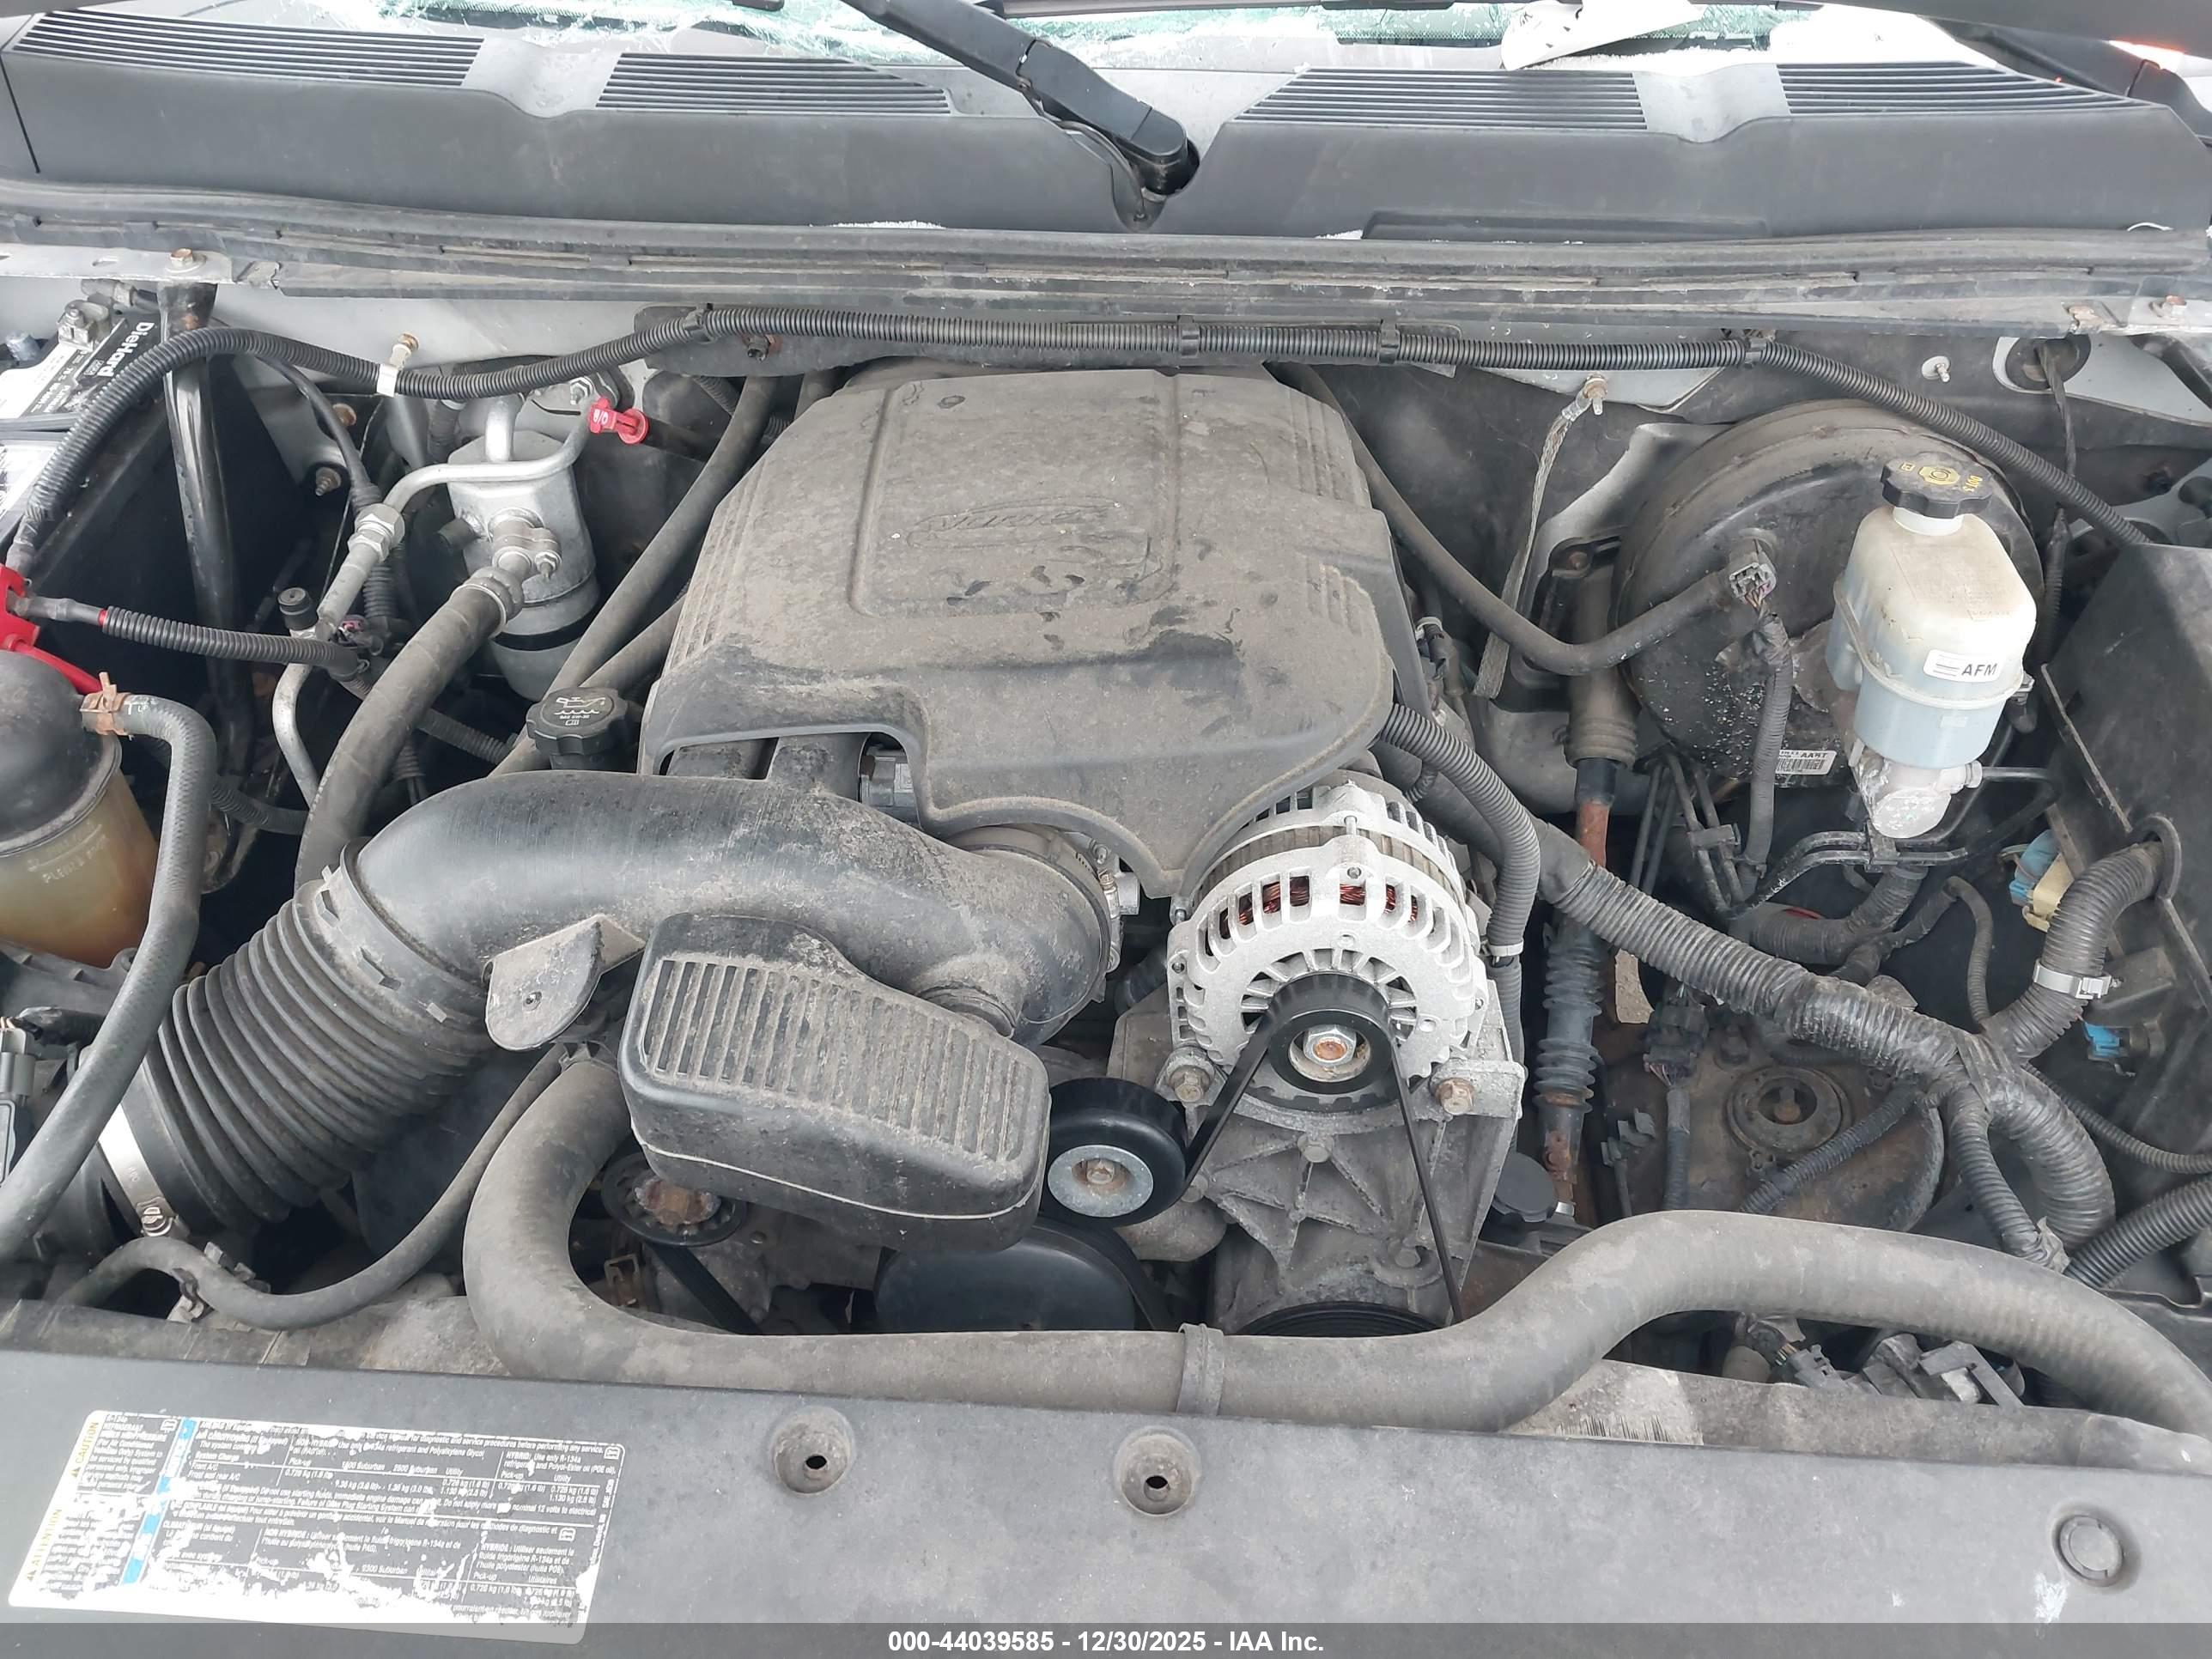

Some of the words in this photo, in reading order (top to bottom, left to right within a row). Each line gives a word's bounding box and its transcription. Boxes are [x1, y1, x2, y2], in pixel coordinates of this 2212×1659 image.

[96, 322, 155, 378] DieHard
[1961, 663, 1997, 677] AFM
[76, 1421, 99, 1463] CAUTION
[419, 1435, 449, 1444] diagnostic
[483, 1439, 516, 1449] procedures
[536, 1443, 568, 1453] performing
[385, 1443, 416, 1454] refrigerant
[465, 1449, 484, 1459] Glycol
[545, 1454, 559, 1463] only
[356, 1462, 386, 1471] Suburban
[444, 1468, 464, 1476] Utility
[591, 1465, 605, 1474] (POE
[500, 1470, 524, 1480] Pick-up
[553, 1474, 571, 1484] Utility
[366, 1493, 387, 1503] engine
[386, 1495, 411, 1504] damage
[443, 1498, 453, 1507] Do
[463, 1500, 481, 1509] apply
[481, 1501, 496, 1510] more
[380, 1504, 403, 1513] System
[403, 1505, 415, 1514] can
[545, 1505, 560, 1514] volts
[561, 1506, 568, 1515] to
[568, 1507, 596, 1516] electrical
[509, 1524, 519, 1533] de
[519, 1525, 550, 1534] diagnostic
[550, 1527, 557, 1535] et
[32, 1509, 62, 1566] ATTENTION
[535, 1546, 567, 1555] seulement
